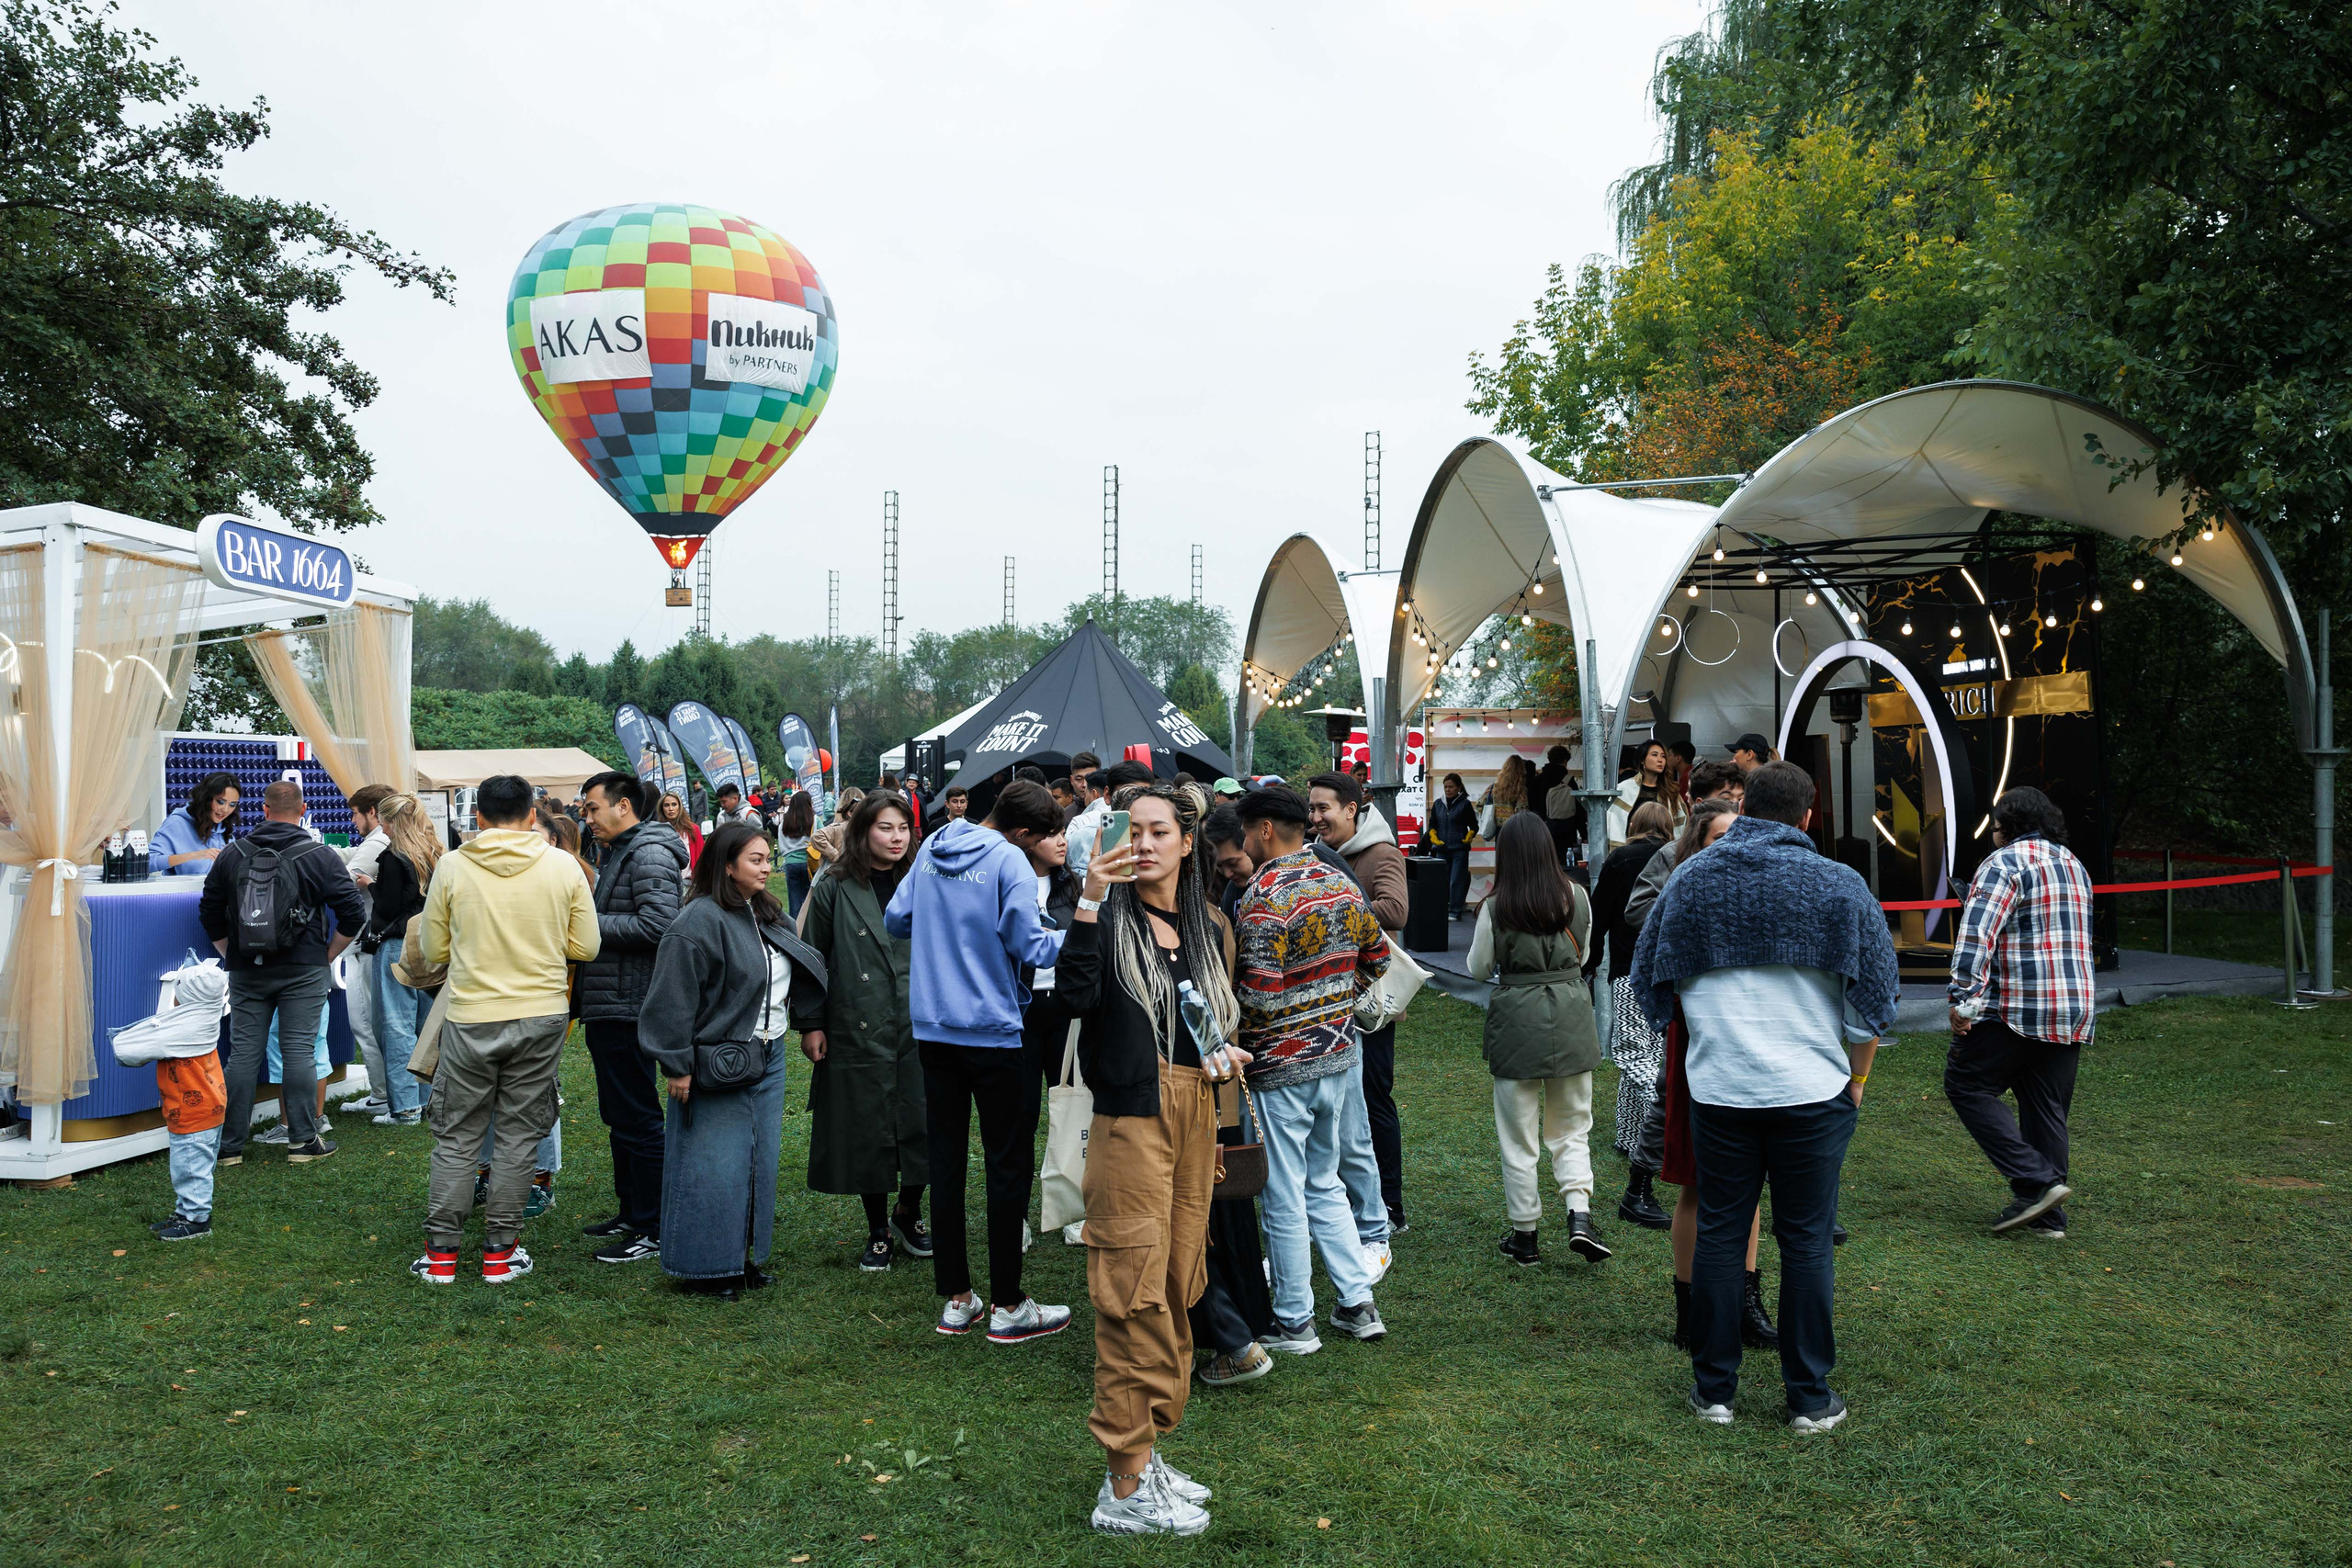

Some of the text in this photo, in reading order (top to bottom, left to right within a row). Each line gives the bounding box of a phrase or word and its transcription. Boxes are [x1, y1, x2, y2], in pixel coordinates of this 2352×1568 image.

[540, 315, 643, 361] AKAS
[729, 355, 798, 376] by PARTNERS
[224, 530, 345, 598] BAR 1664
[987, 721, 1049, 739] MAKE IT
[1170, 725, 1210, 748] COU
[975, 735, 1039, 753] COUNT
